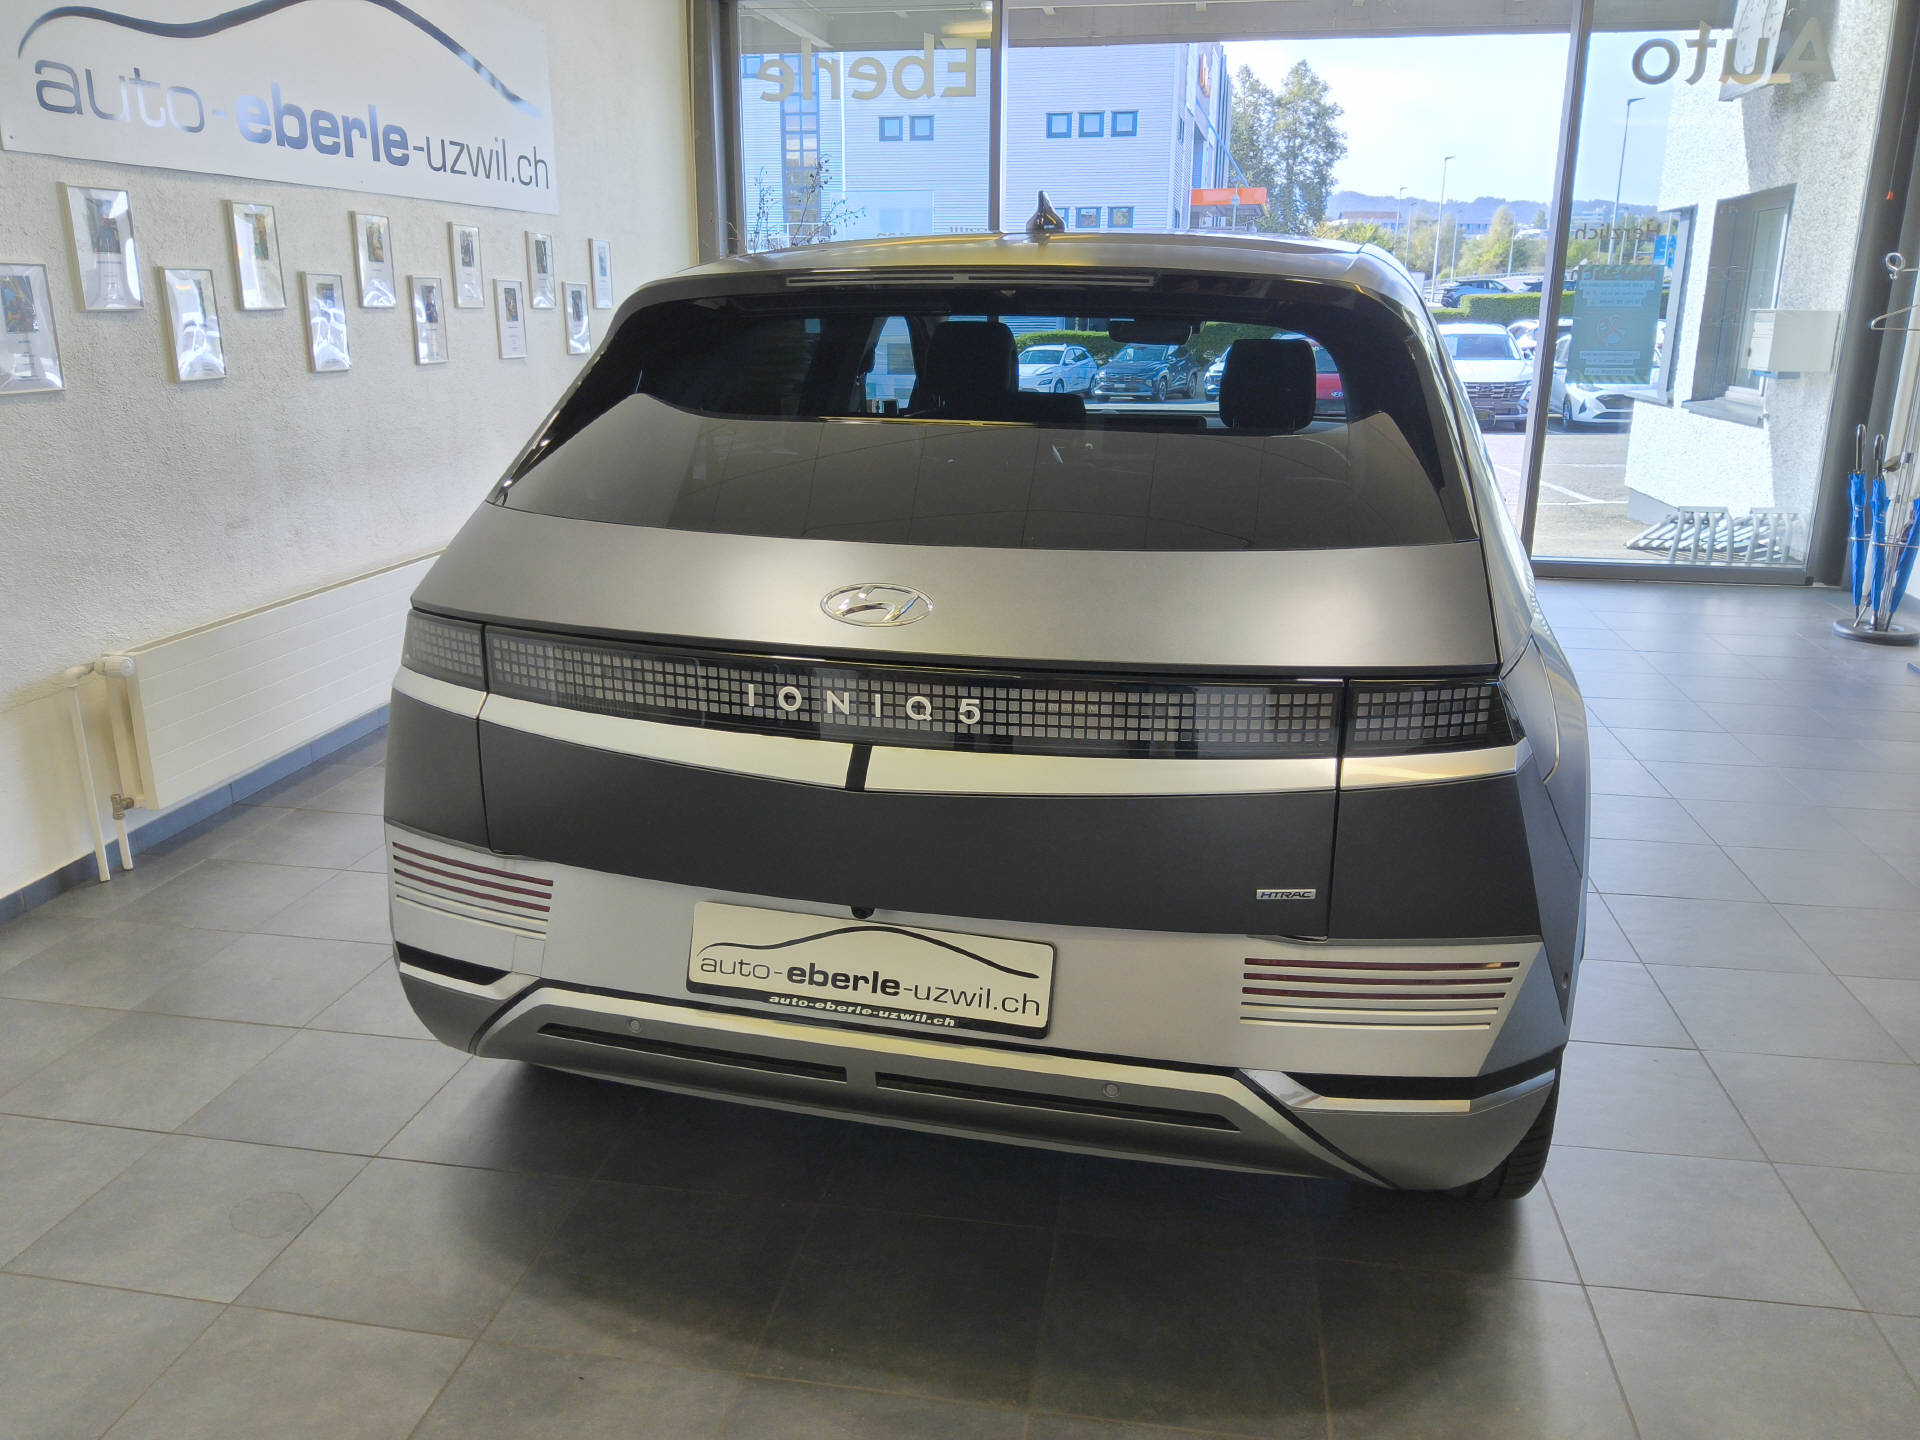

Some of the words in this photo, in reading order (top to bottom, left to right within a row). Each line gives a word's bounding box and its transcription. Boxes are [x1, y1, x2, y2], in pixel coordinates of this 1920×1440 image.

[34, 59, 550, 190] auto-eberle-uzwil.ch
[1259, 890, 1313, 899] HTRAC
[700, 955, 1041, 1017] auto-eberle-uzwil.ch
[769, 994, 956, 1027] auto-eberle-uzwil.ch
